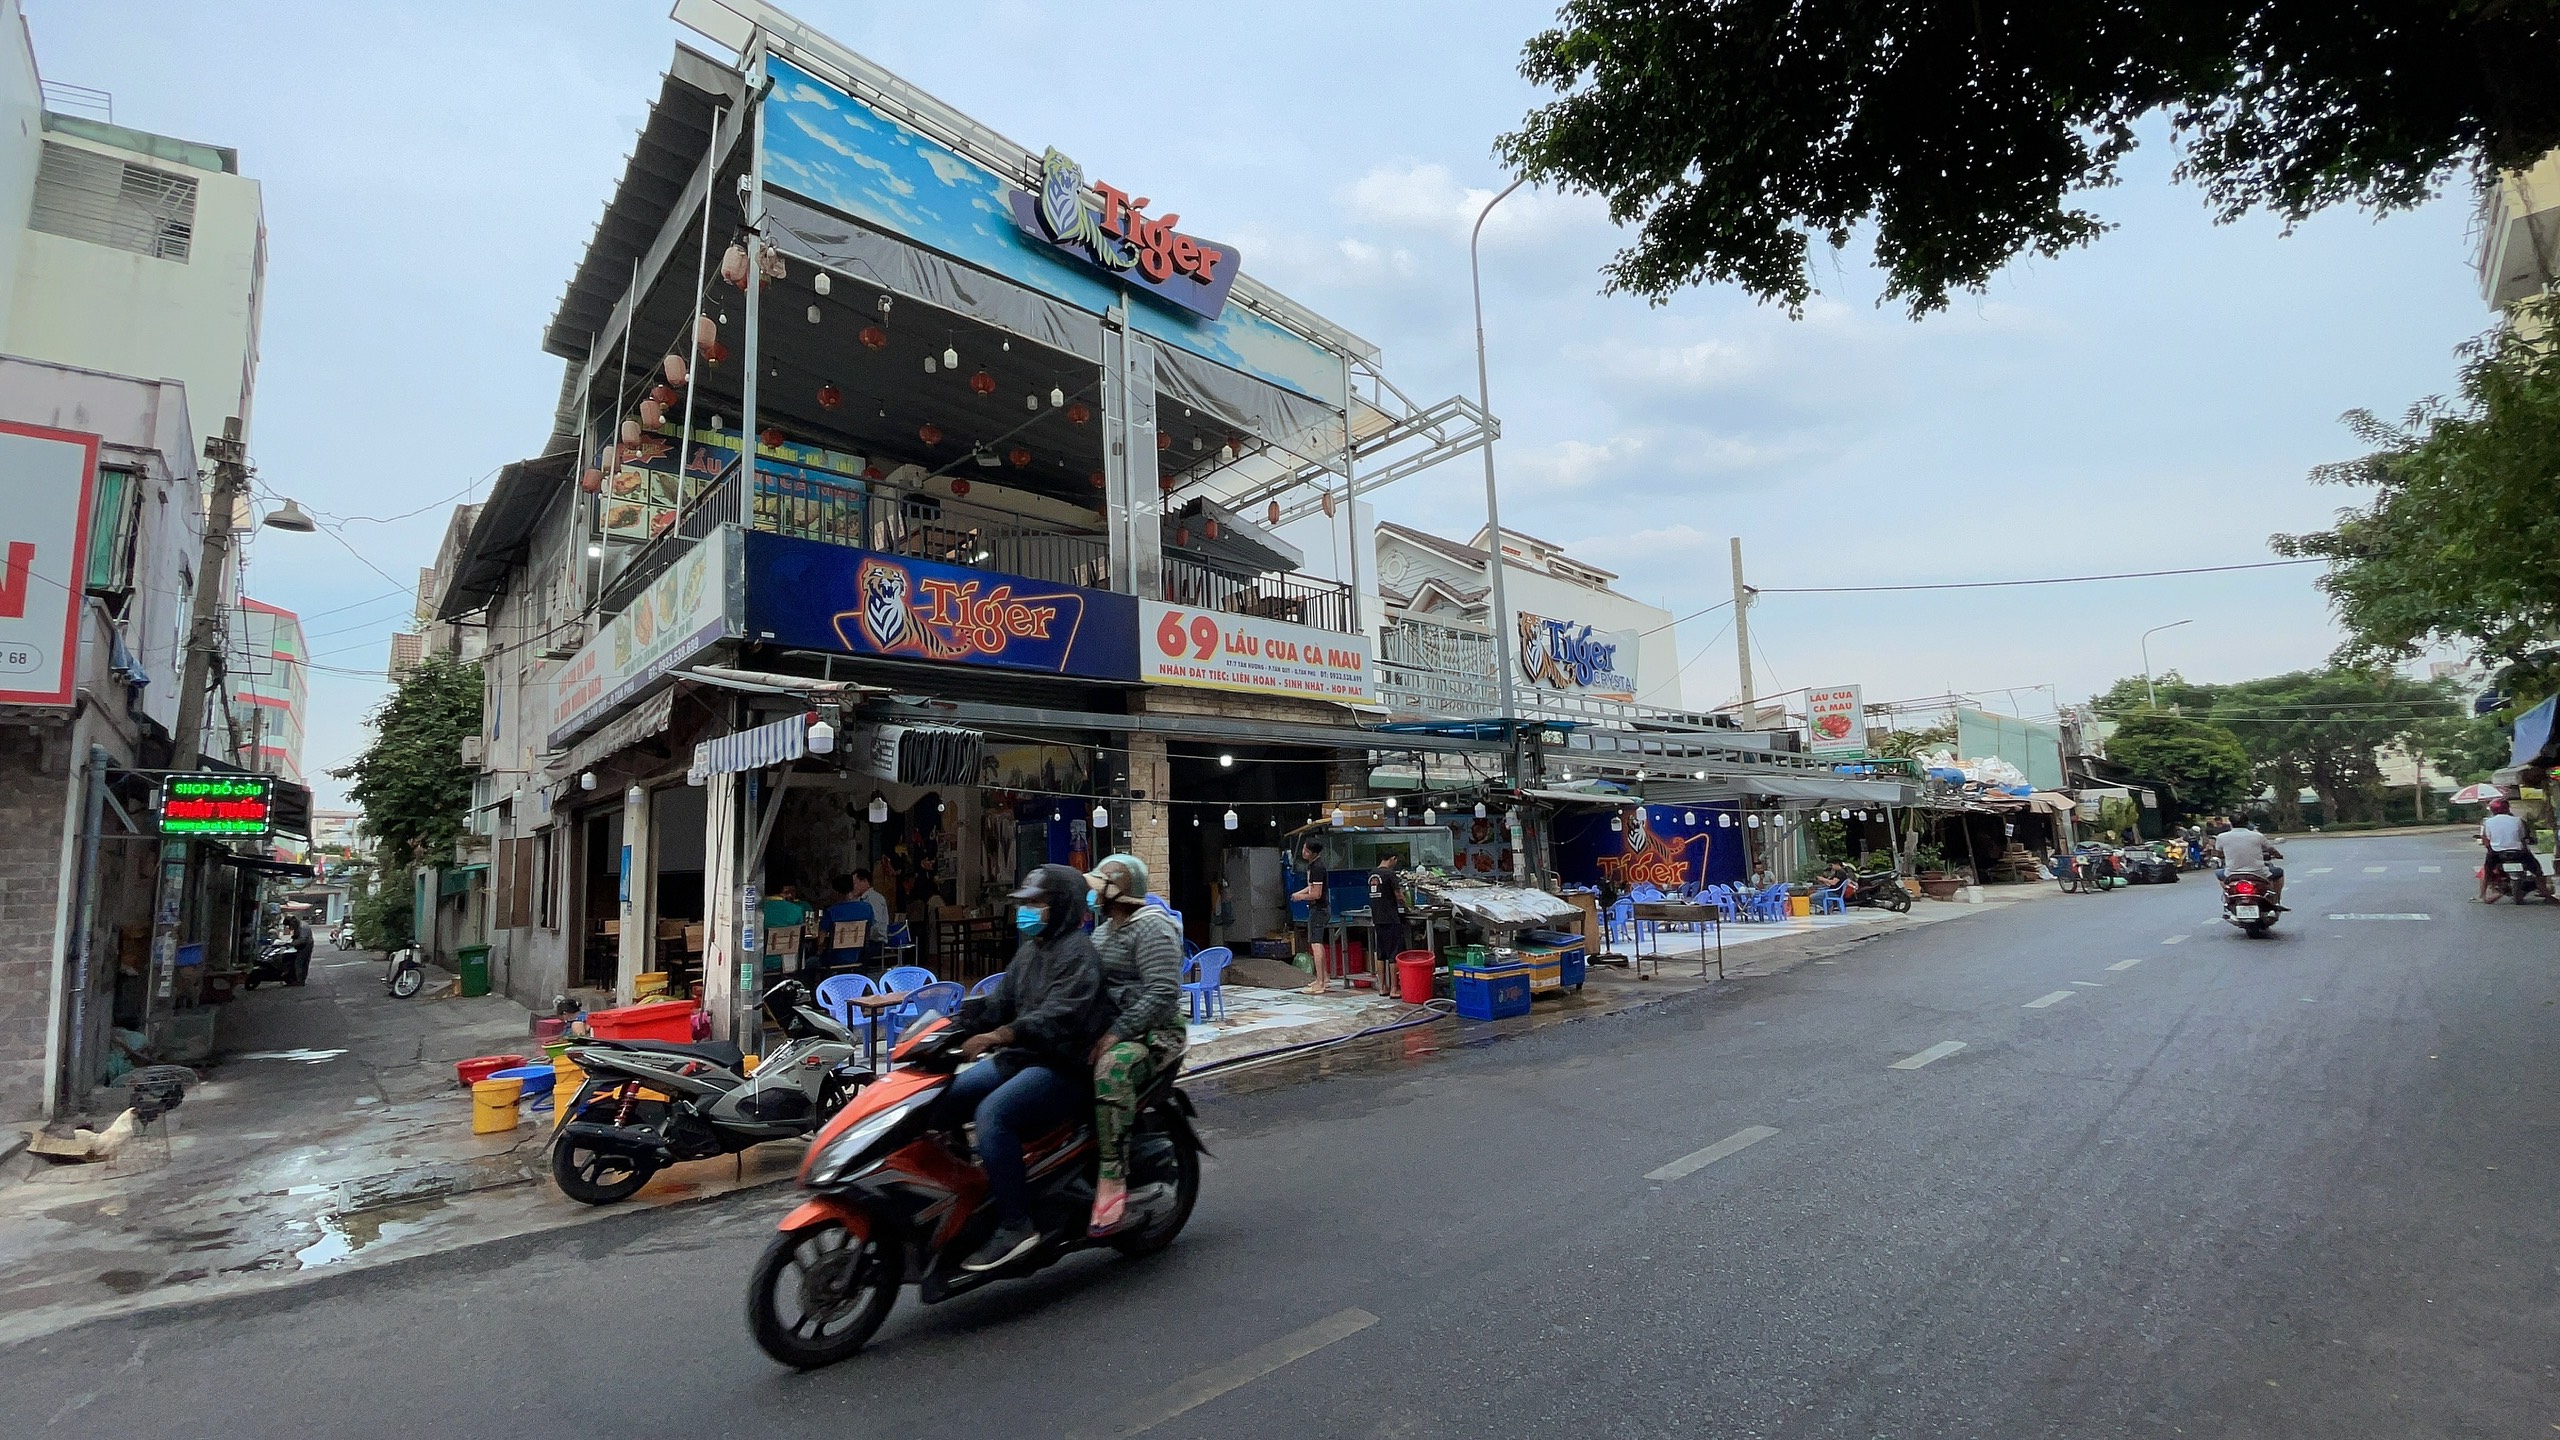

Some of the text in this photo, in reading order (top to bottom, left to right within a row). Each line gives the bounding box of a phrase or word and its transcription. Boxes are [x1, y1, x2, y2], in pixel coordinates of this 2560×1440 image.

[1092, 179, 1222, 285] Tiger
[920, 579, 1056, 654] Tiger
[1157, 611, 1219, 661] 69
[1225, 628, 1361, 670] LẨU CUA CÀ MAU
[9, 652, 27, 664] 68
[1543, 620, 1617, 686] Tiger
[1232, 672, 1250, 683] LIÊN
[1252, 675, 1276, 686] HOAN
[1284, 678, 1304, 689] SINH
[1592, 671, 1638, 692] CRYSTAL
[1829, 703, 1852, 711] MAU
[1832, 691, 1853, 700] CUA
[175, 783, 210, 795] SHOP
[1597, 852, 1688, 888] Tiger
